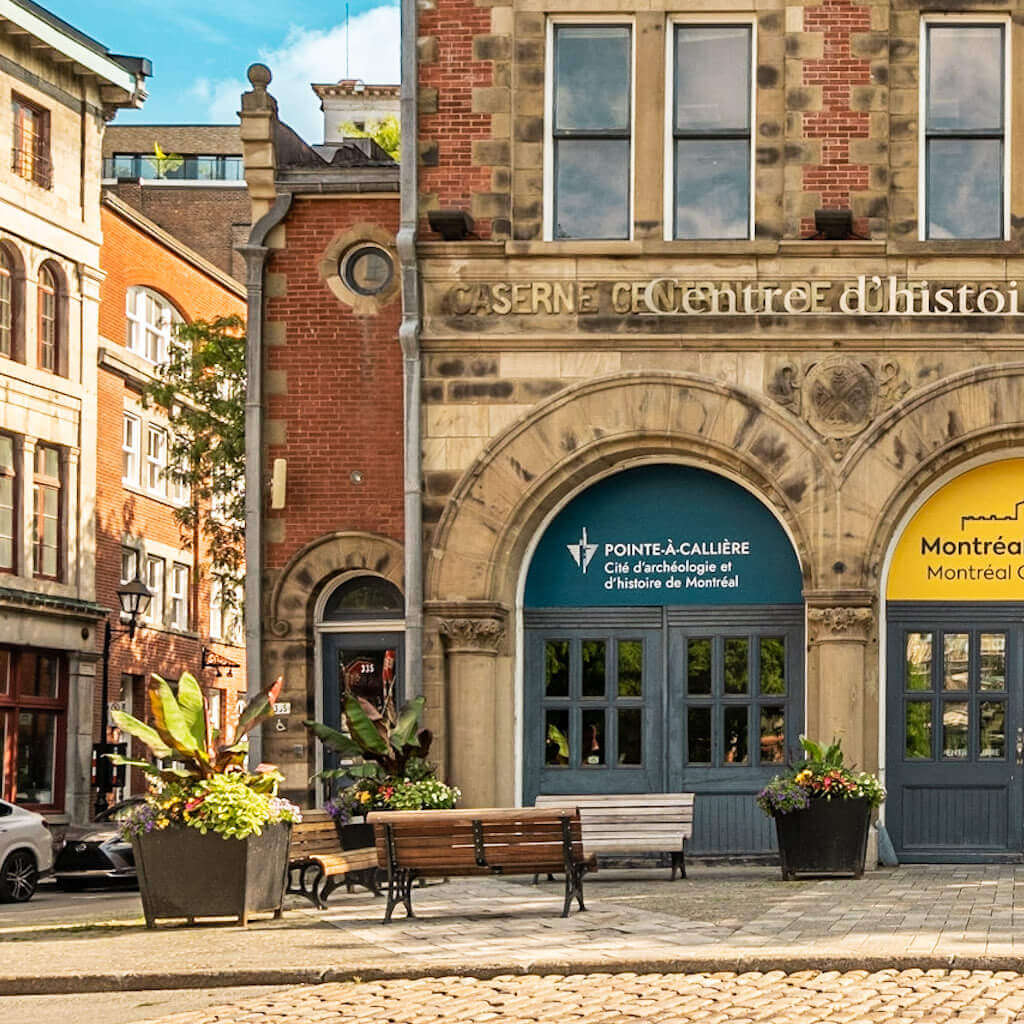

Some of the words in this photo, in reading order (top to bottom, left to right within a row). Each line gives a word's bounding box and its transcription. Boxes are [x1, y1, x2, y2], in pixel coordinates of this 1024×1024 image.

[452, 280, 598, 315] CASERNE
[646, 276, 809, 315] Centre
[604, 539, 750, 556] POINTE-À-CALLIÈRE
[604, 561, 630, 574] Cité
[633, 560, 716, 576] d'archéologie
[720, 561, 732, 572] et
[927, 565, 1011, 580] Montréal
[604, 577, 662, 590] d'histoire
[665, 576, 681, 589] de
[686, 575, 739, 588] Montréal
